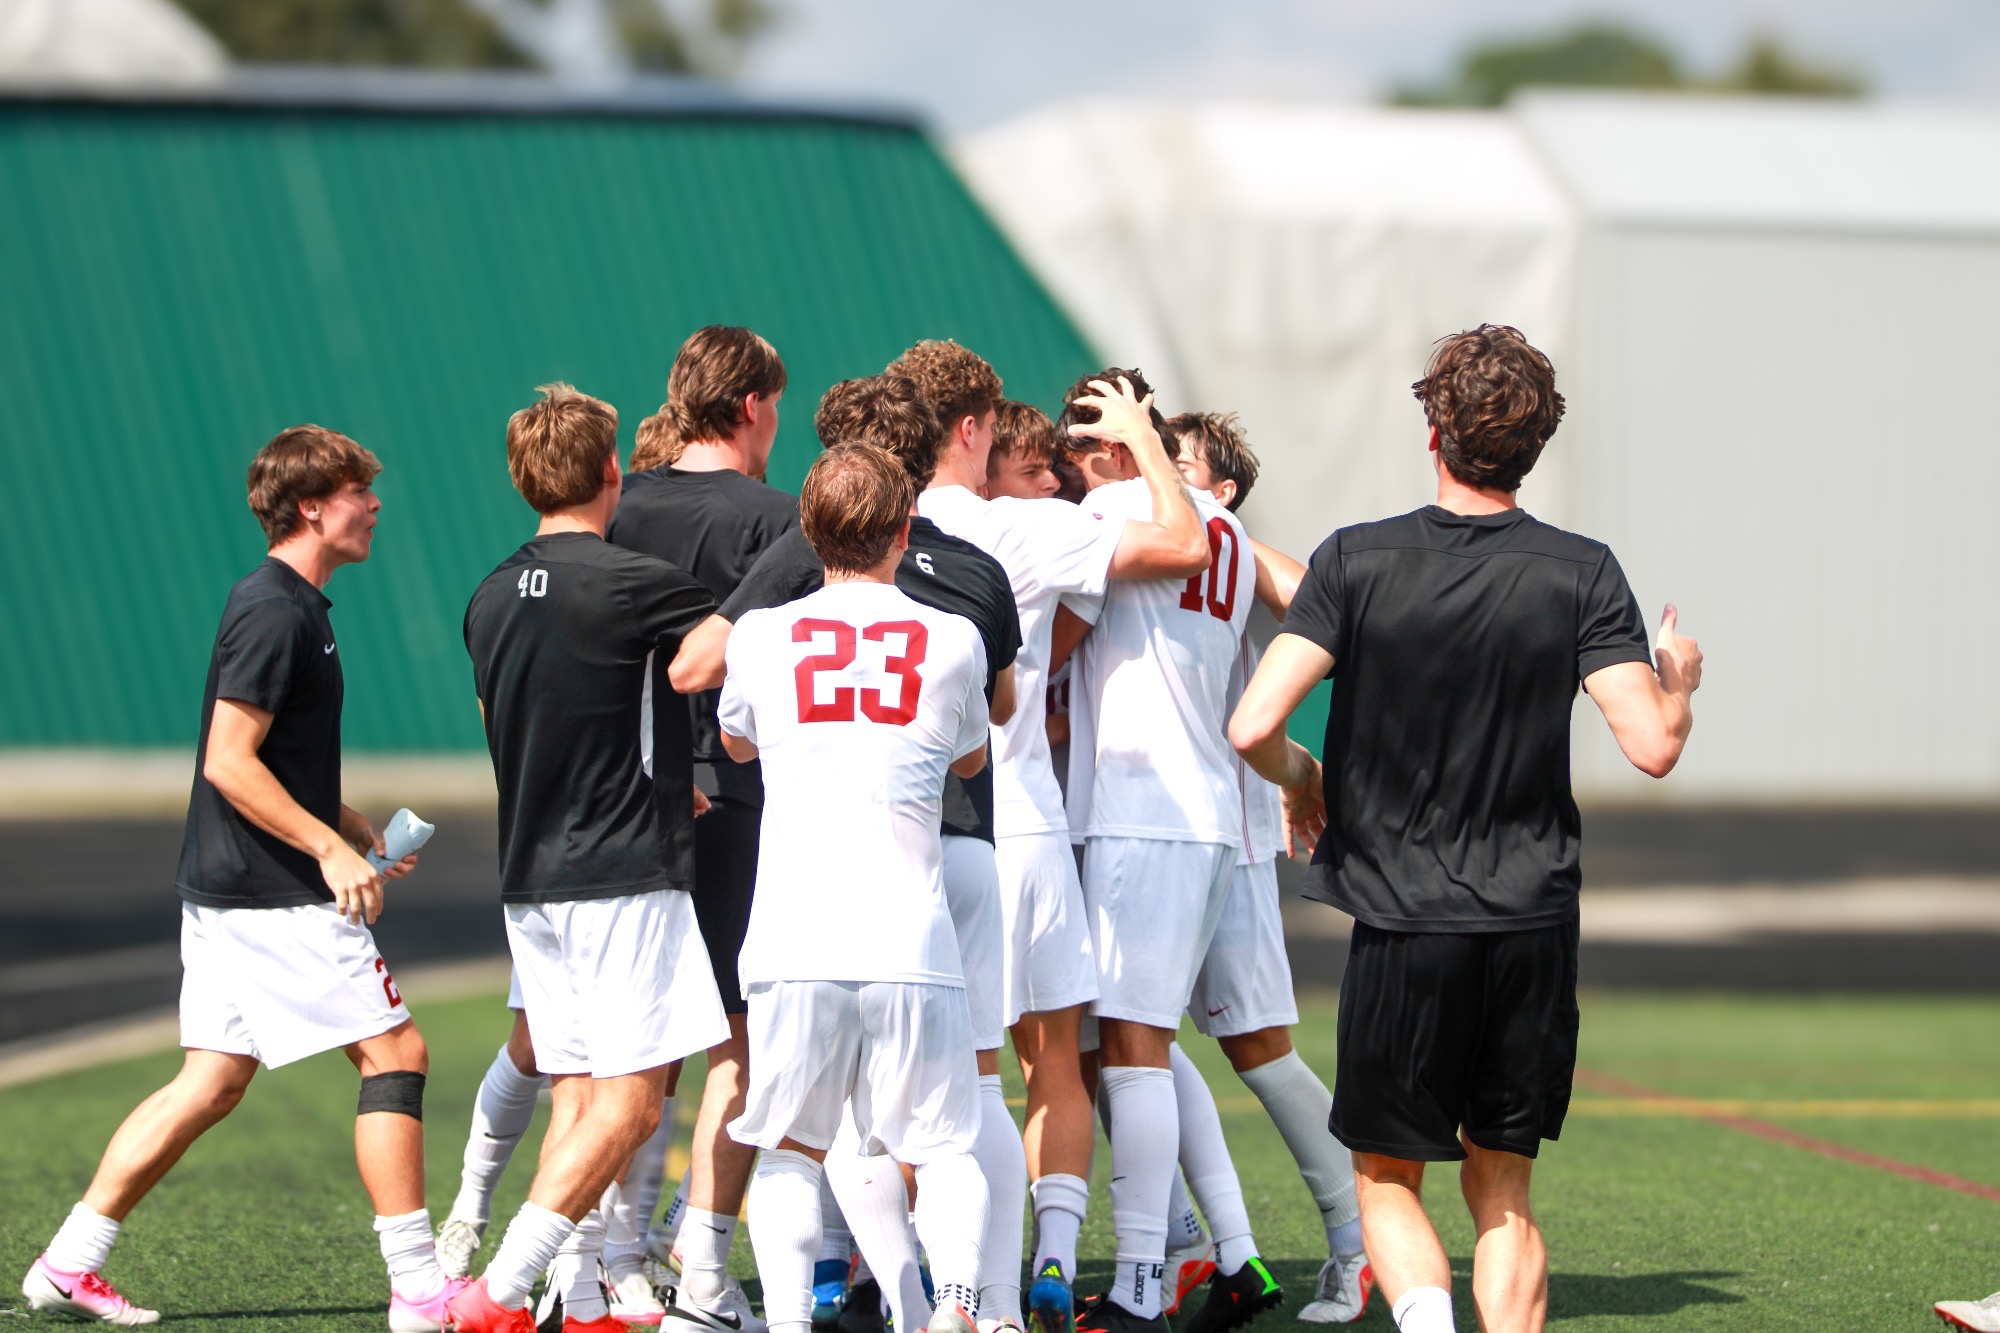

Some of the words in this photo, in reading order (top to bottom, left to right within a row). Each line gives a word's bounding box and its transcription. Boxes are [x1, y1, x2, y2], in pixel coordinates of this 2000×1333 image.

[915, 552, 935, 575] 6
[517, 568, 549, 598] 40
[791, 617, 929, 727] 23
